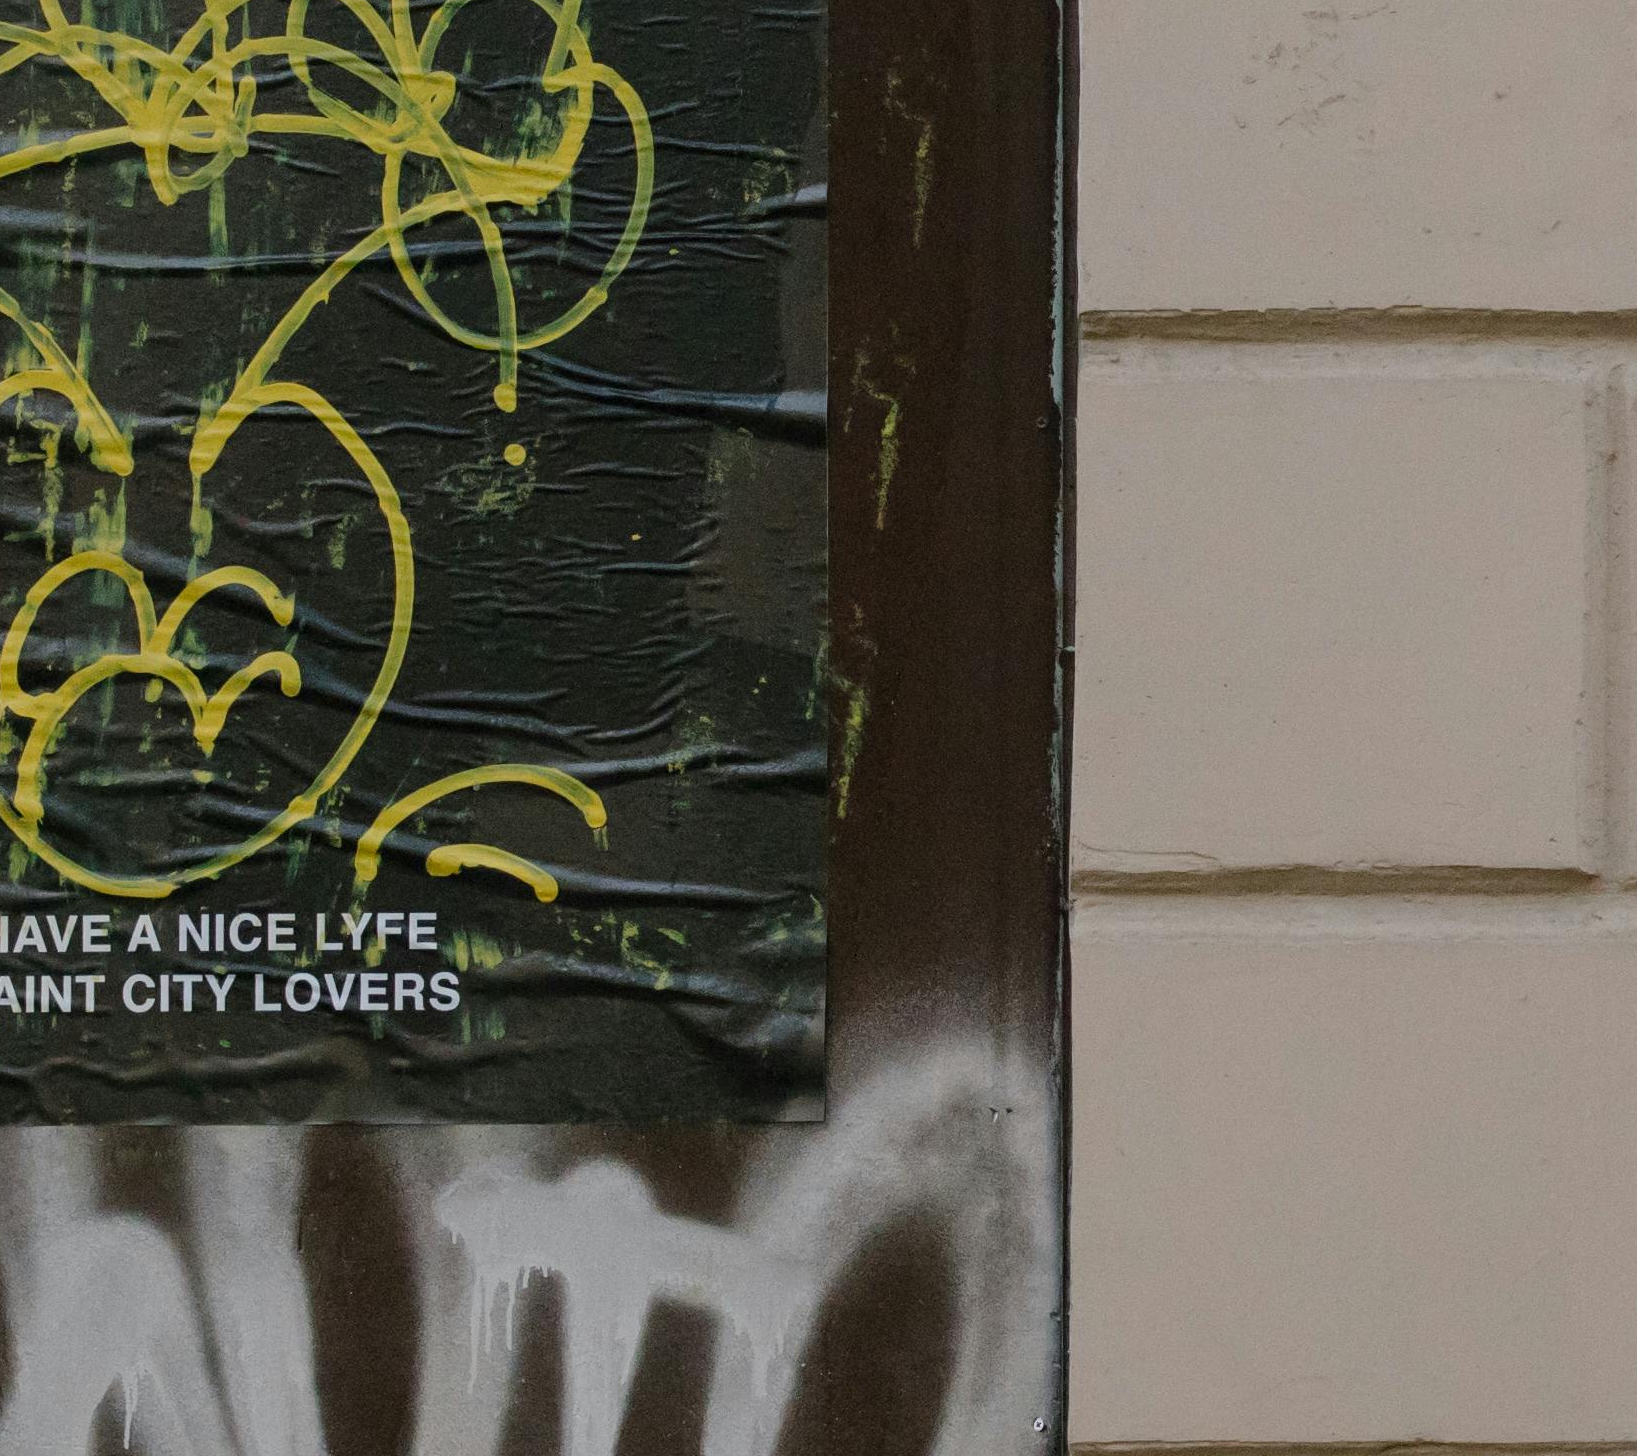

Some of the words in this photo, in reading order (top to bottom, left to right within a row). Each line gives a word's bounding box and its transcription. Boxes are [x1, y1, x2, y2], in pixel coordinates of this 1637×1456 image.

[127, 914, 162, 953] A
[178, 912, 297, 953] NICE
[316, 911, 438, 951] LYFE
[122, 973, 236, 1014] CITY
[254, 971, 461, 1013] LOVERS
